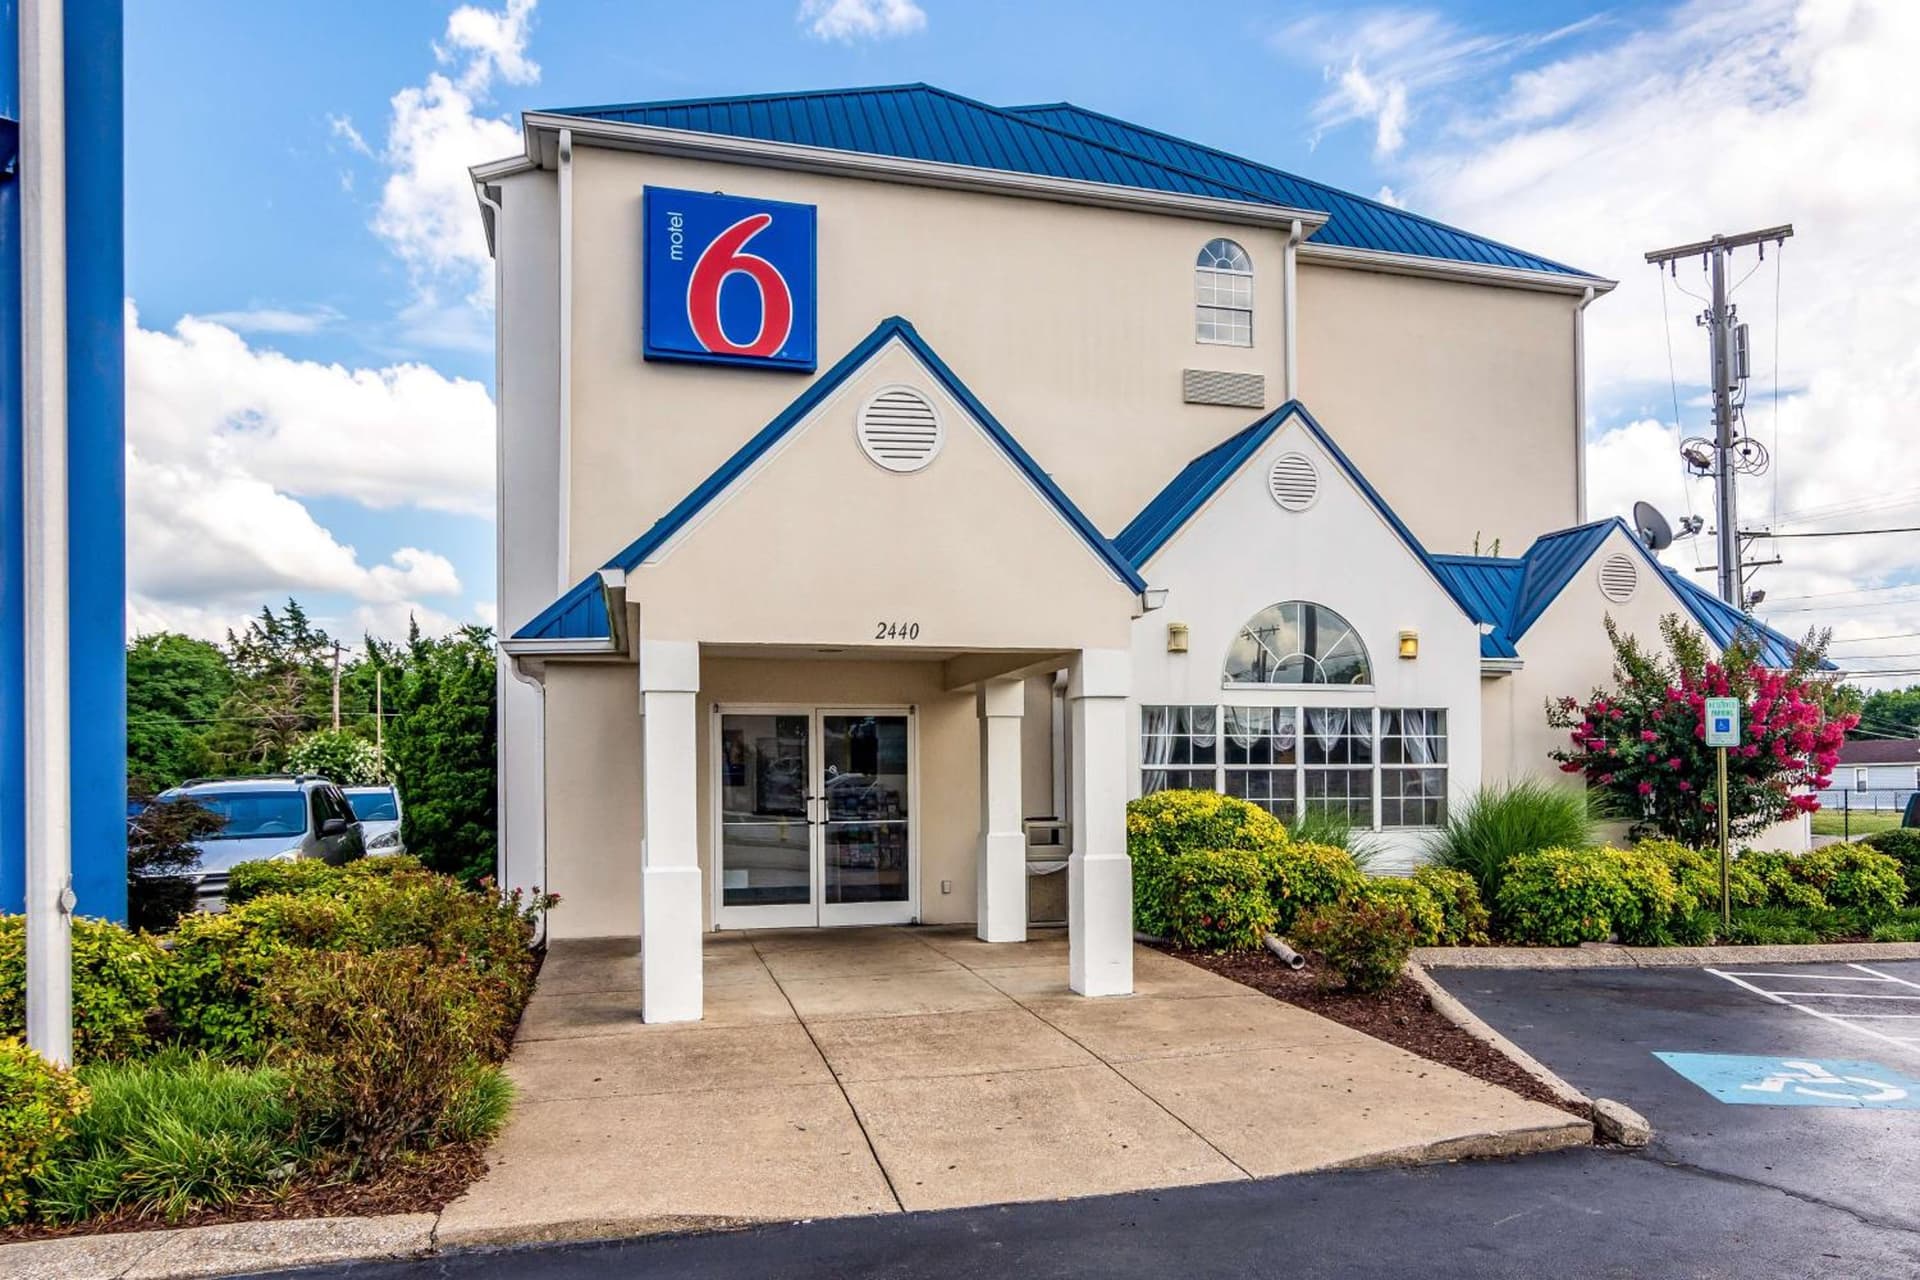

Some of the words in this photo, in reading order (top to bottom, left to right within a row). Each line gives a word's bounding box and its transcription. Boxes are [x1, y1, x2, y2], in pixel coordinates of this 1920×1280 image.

[667, 211, 683, 261] motel
[687, 213, 793, 358] 6
[875, 621, 920, 641] 2440
